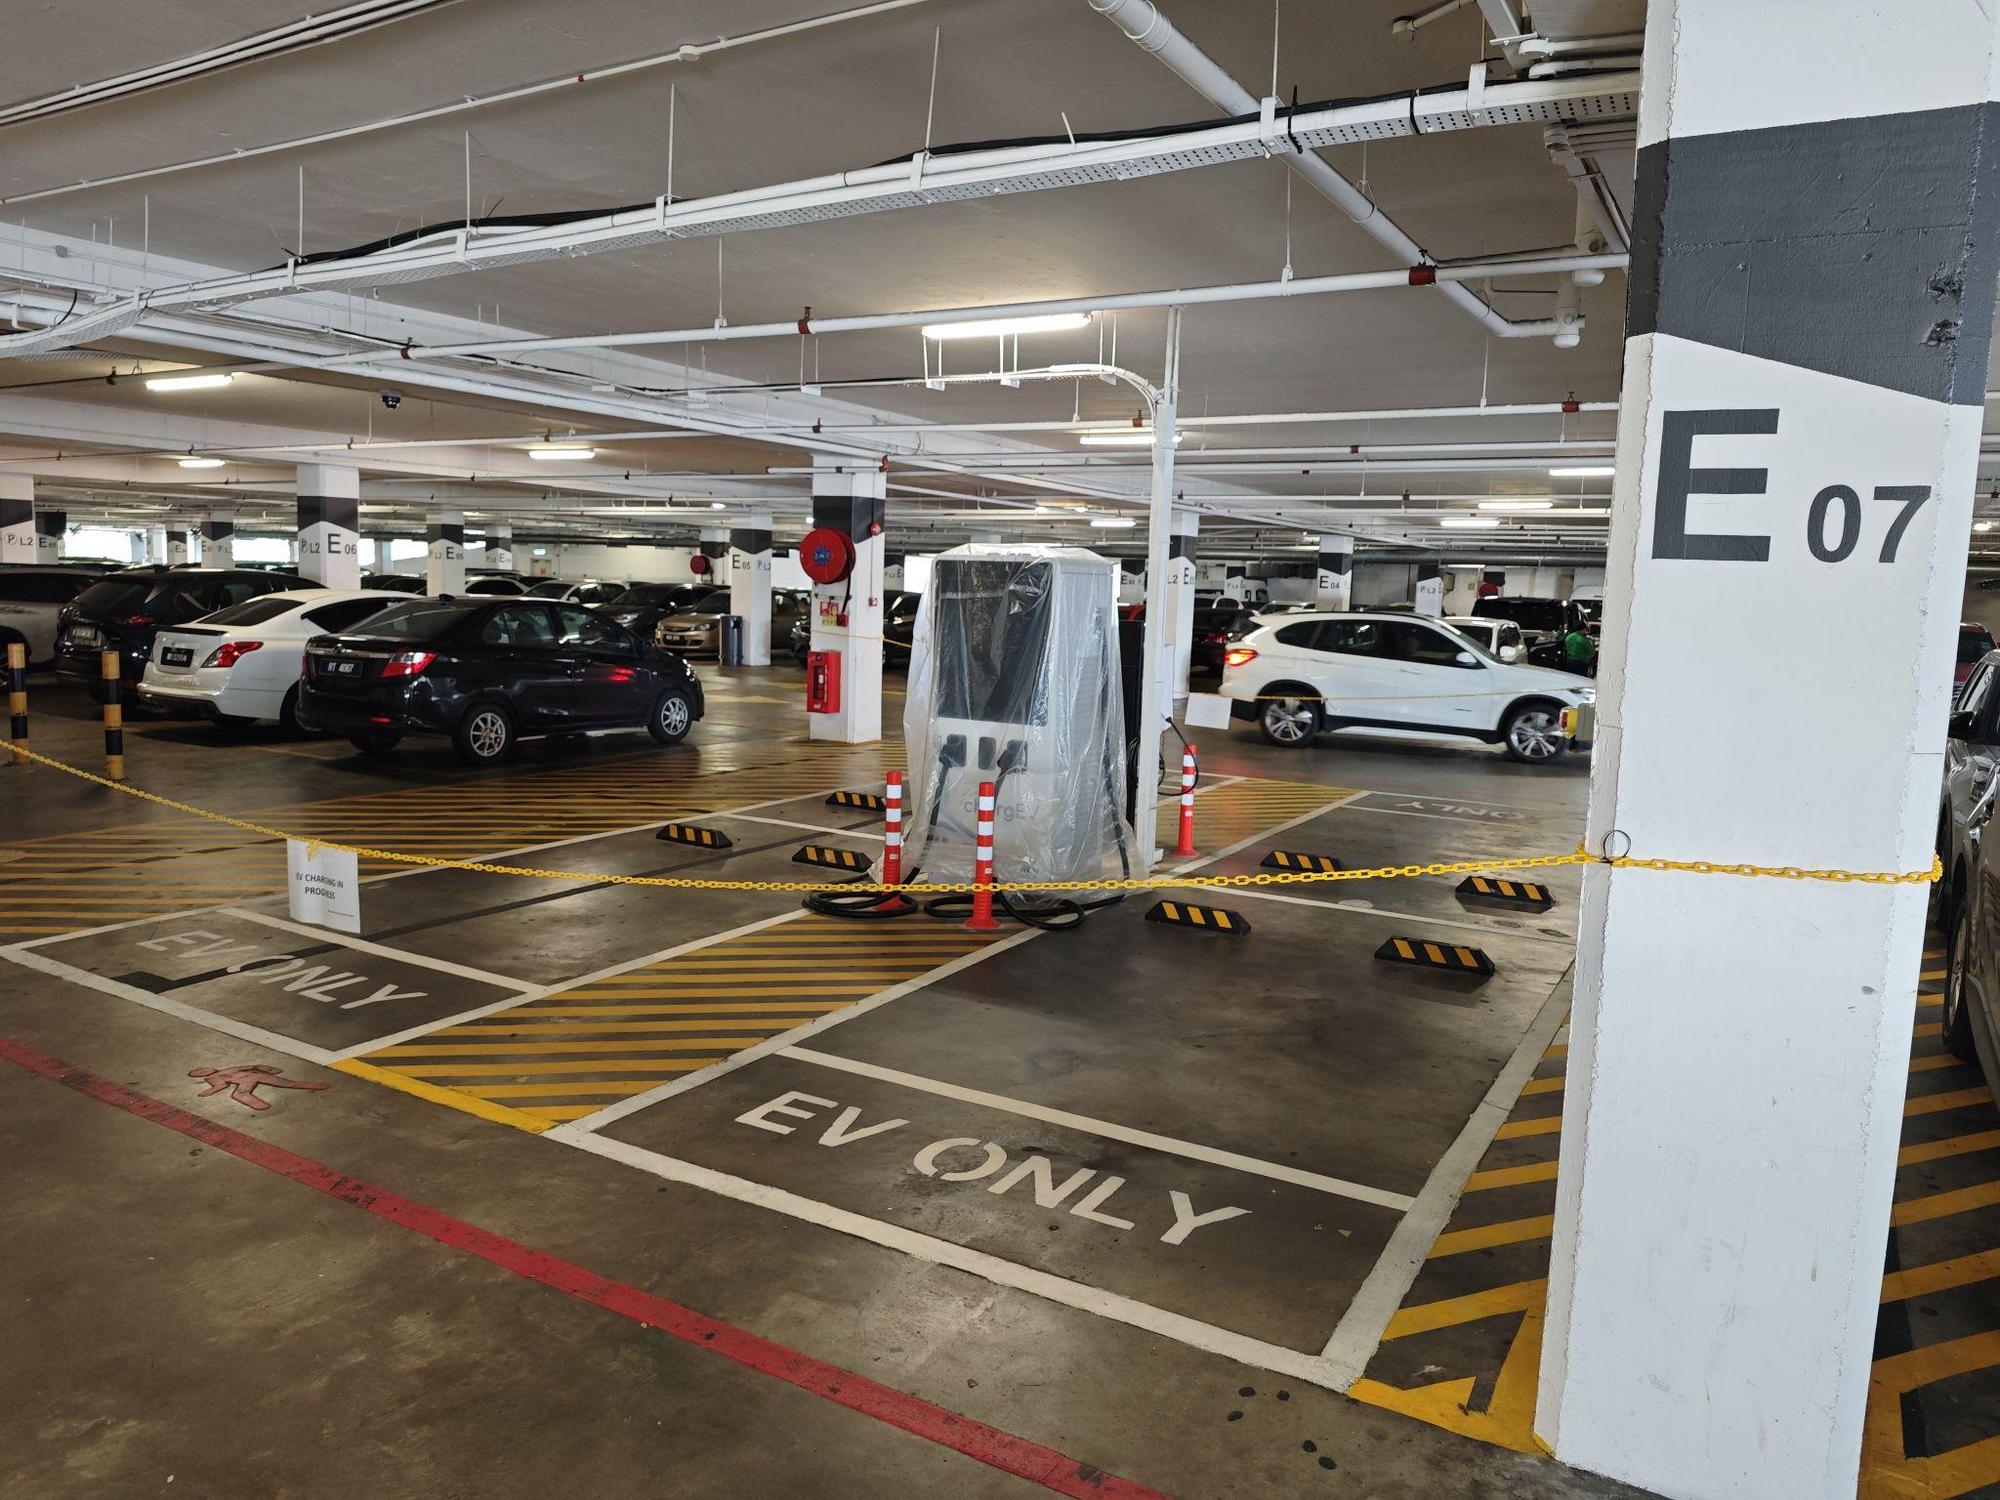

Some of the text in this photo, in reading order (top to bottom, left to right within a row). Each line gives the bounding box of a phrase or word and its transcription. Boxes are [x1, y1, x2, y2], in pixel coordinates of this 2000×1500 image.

[1651, 408, 1931, 563] E 07
[20, 537, 33, 546] L2
[39, 537, 47, 547] E
[310, 543, 320, 554] L2
[328, 533, 358, 555] E 06
[446, 546, 454, 559] E
[732, 554, 750, 570] E 05
[1121, 575, 1128, 585] E
[1184, 567, 1189, 584] E
[1319, 576, 1329, 588] E
[1395, 801, 1525, 819] ONLY
[337, 880, 344, 888] IN
[136, 929, 428, 1010] EV ONLY
[735, 1090, 1252, 1246] EV ONLY
